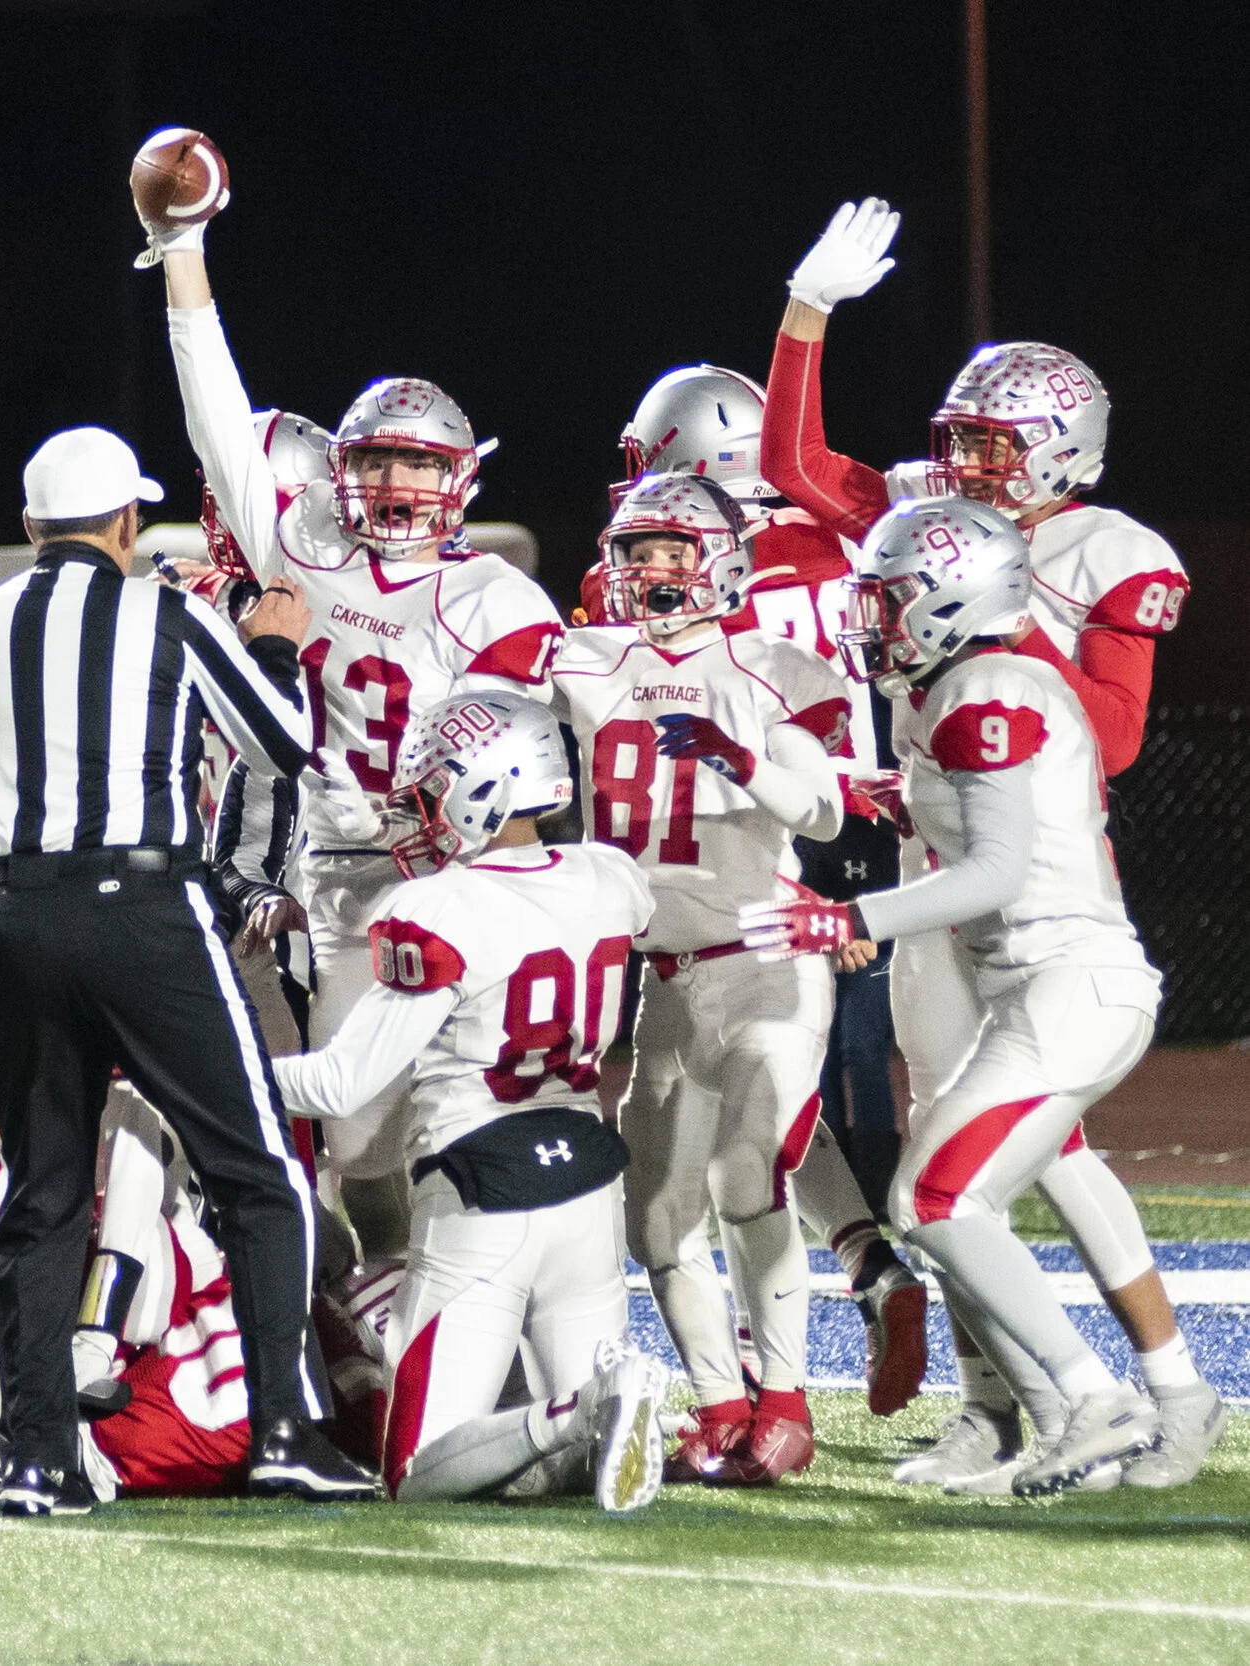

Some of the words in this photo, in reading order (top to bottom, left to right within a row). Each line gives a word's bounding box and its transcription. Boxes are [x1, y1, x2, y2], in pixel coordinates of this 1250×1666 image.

[1046, 365, 1093, 412] 89
[926, 527, 961, 566] 9
[330, 603, 406, 642] CARTHAGE
[1135, 581, 1185, 632] 89
[299, 636, 413, 796] 13
[632, 684, 704, 703] CARTHAGE
[439, 702, 497, 752] 80
[979, 715, 1010, 764] 9
[592, 718, 701, 867] 81
[376, 937, 426, 986] 80
[483, 934, 634, 1105] 80
